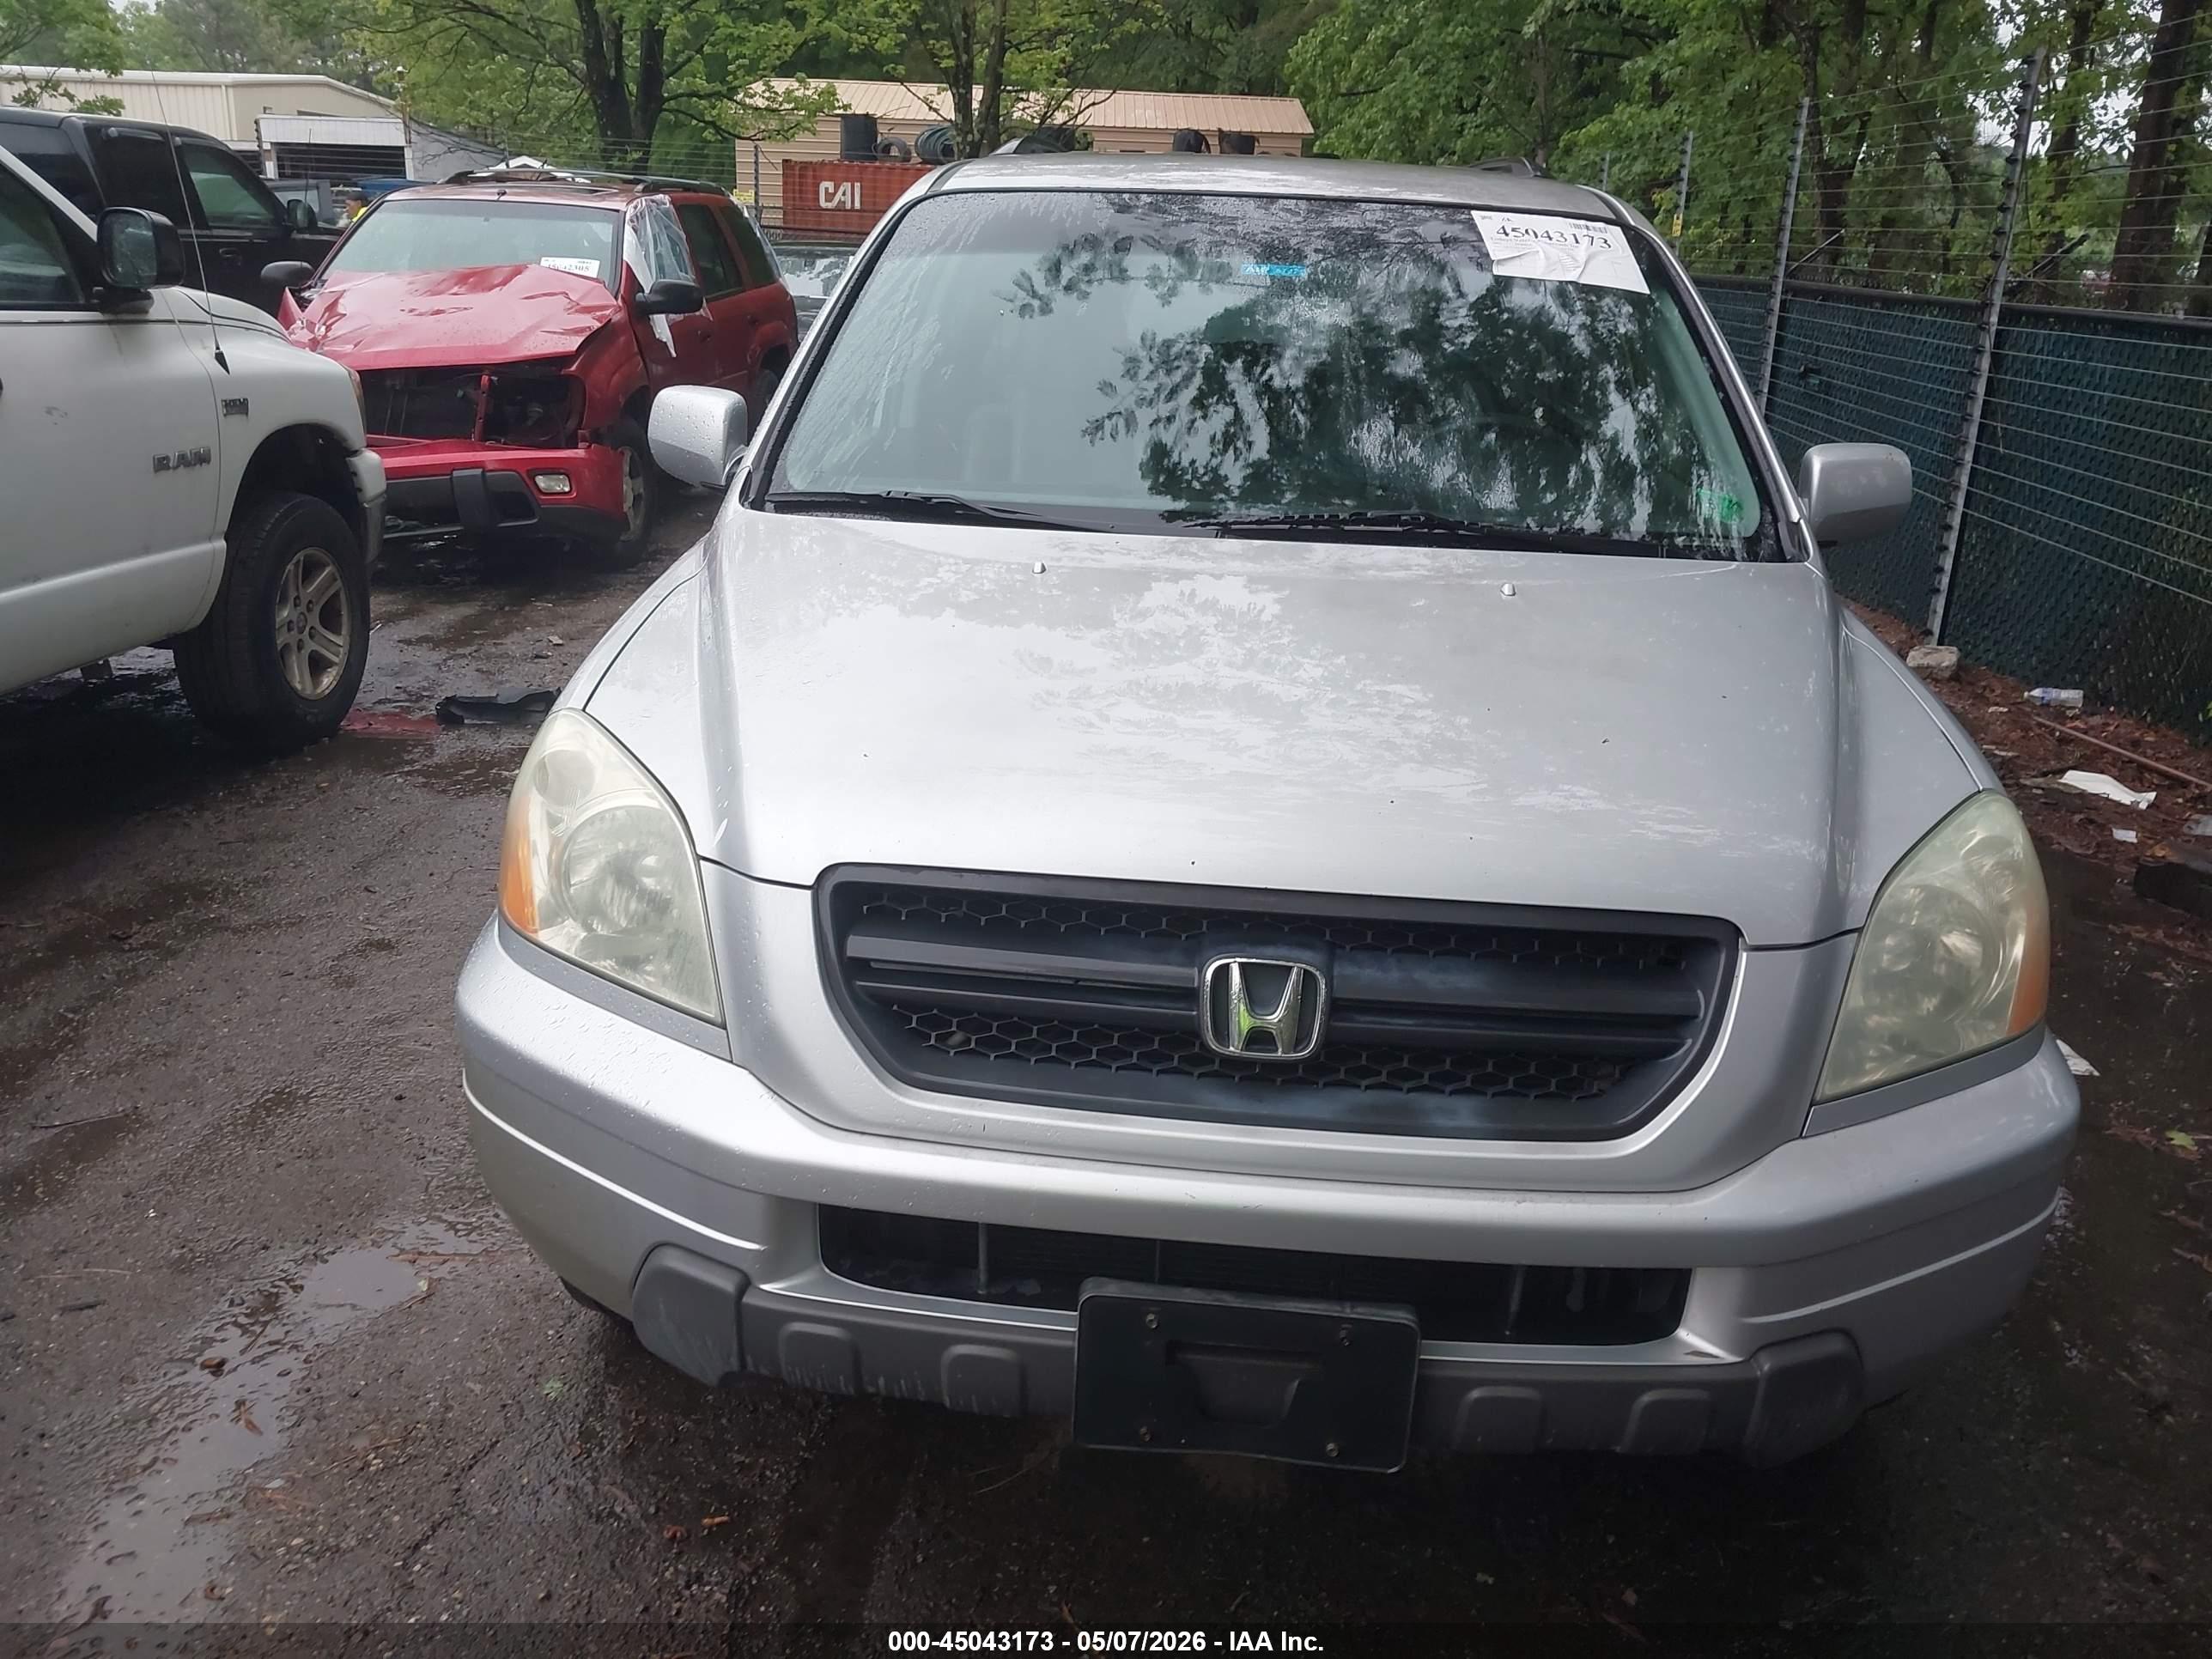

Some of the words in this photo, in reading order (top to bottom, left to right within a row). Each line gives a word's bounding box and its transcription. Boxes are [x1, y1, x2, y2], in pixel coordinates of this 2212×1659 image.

[818, 180, 861, 210] CAI
[1496, 225, 1612, 250] 45043173
[153, 447, 212, 473] RAM
